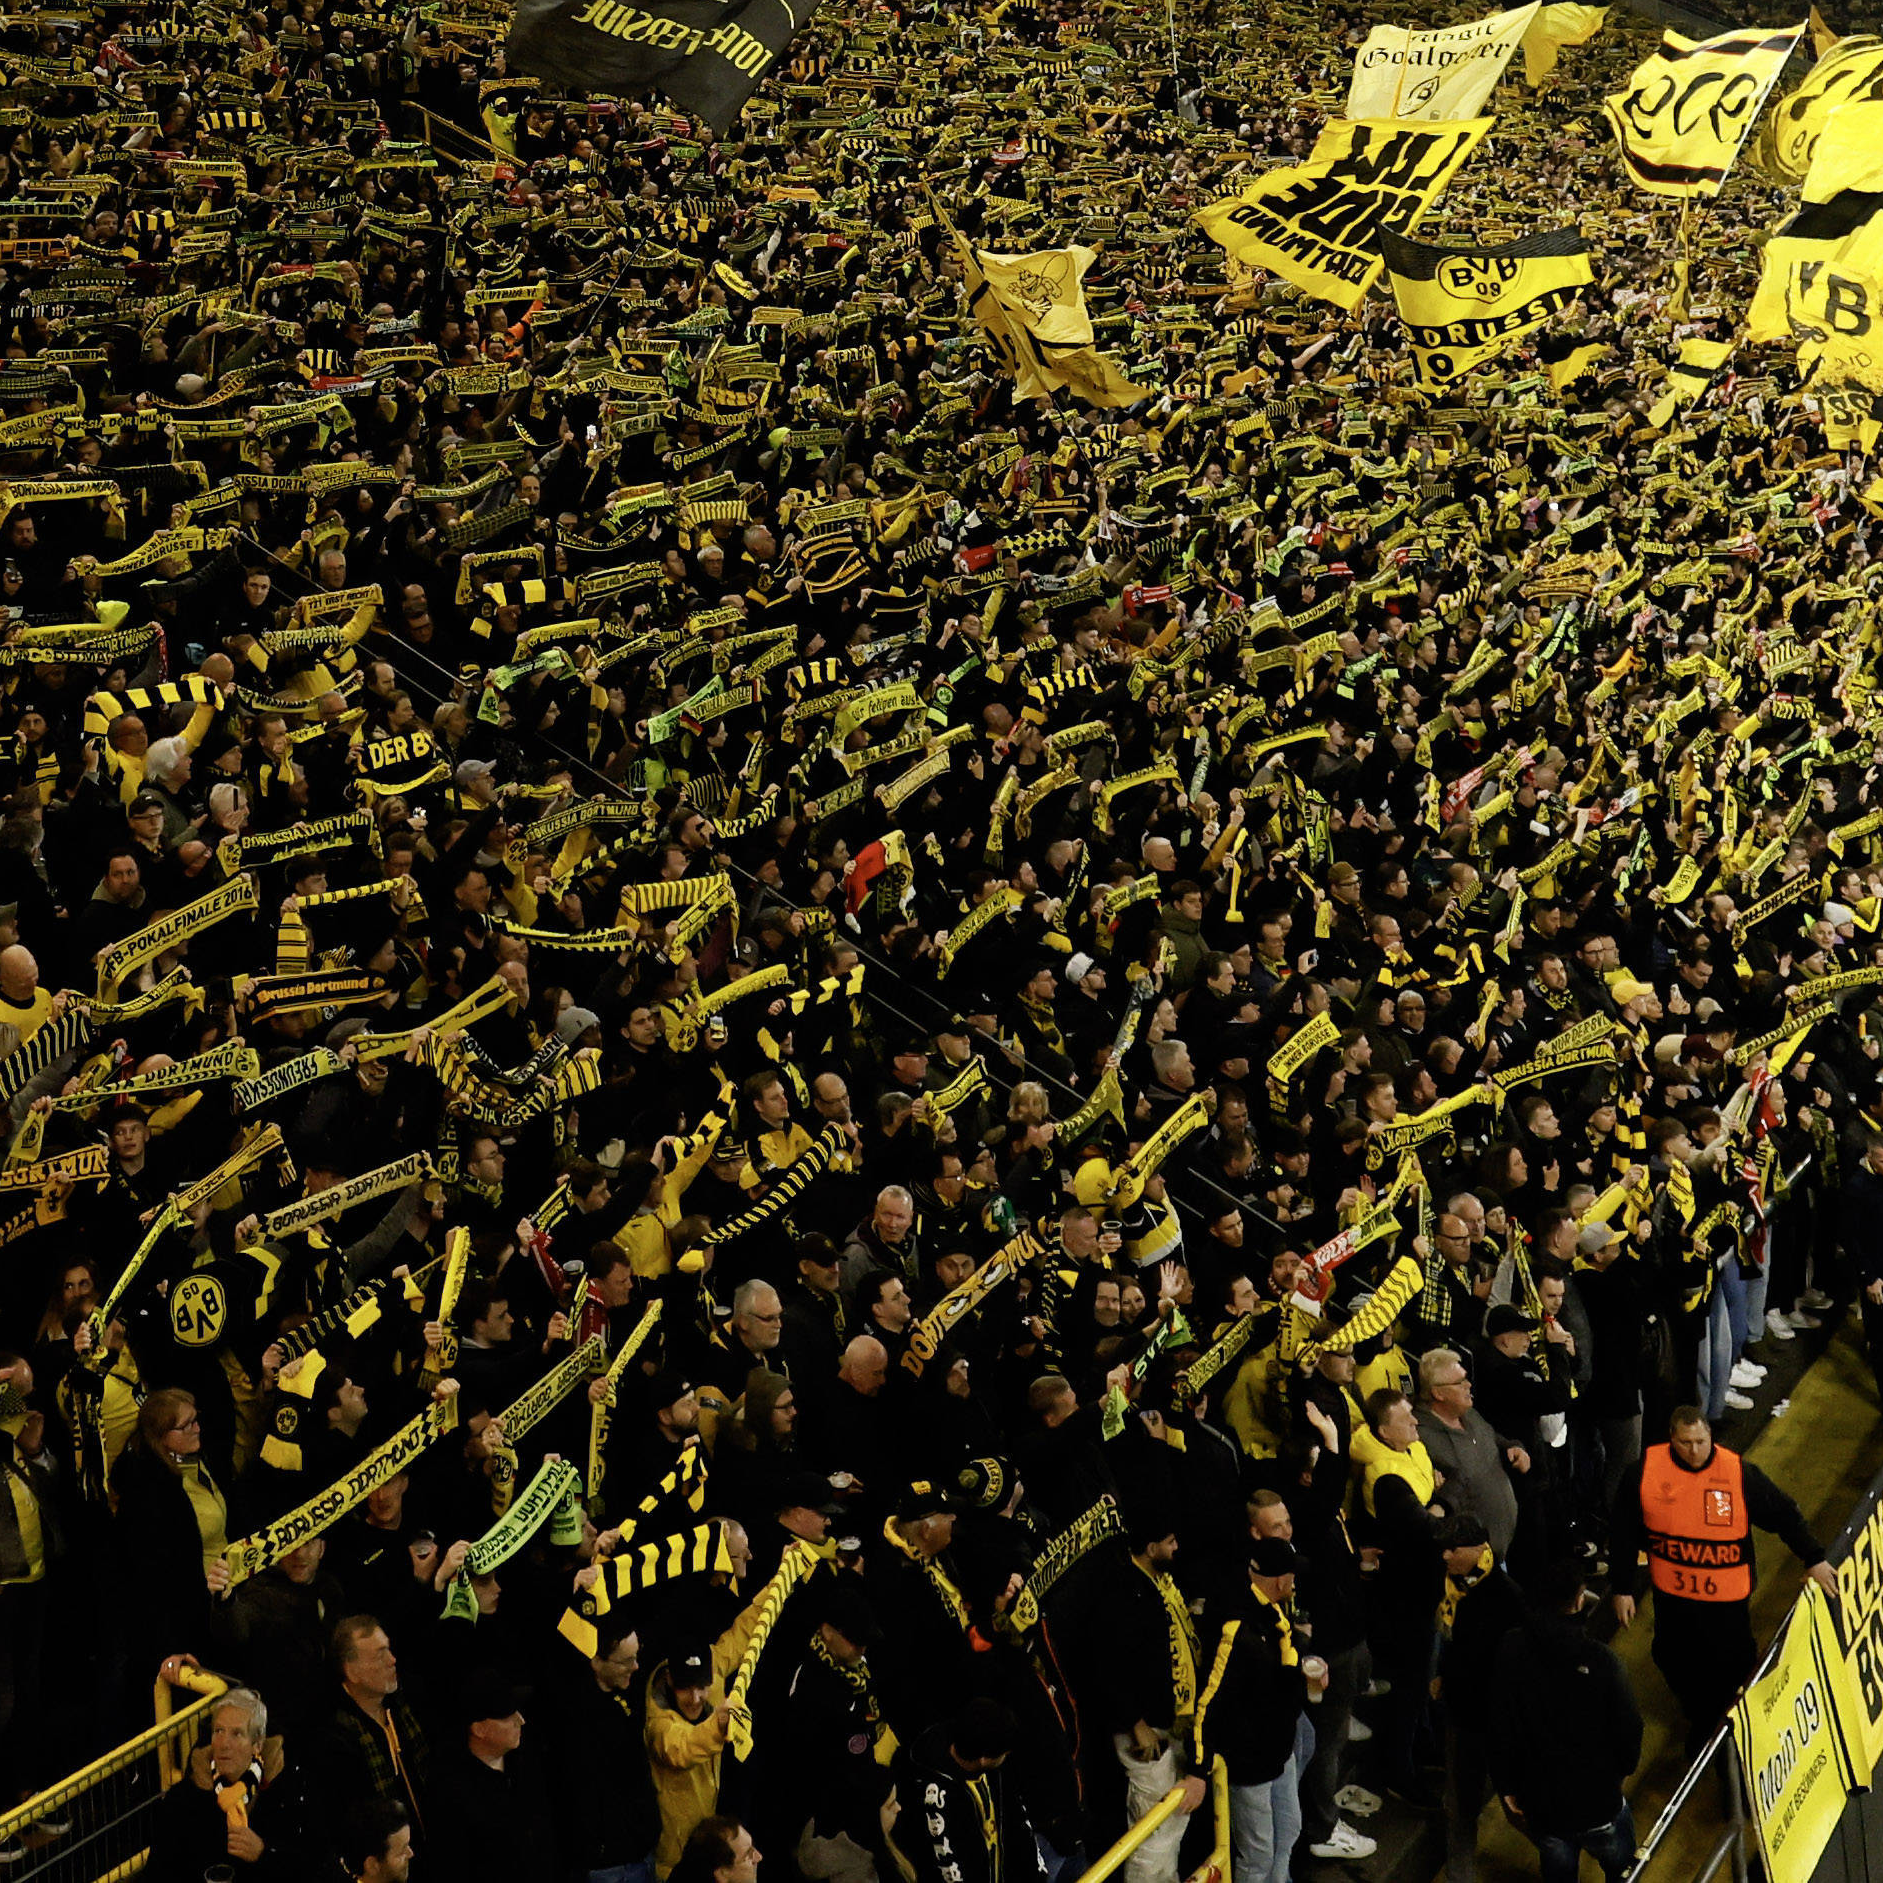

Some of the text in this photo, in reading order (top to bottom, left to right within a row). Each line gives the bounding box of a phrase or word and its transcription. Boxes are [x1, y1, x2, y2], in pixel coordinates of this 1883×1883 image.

[1476, 280, 1501, 298] 09
[367, 737, 409, 769] DER
[304, 812, 371, 837] DORTMUN
[223, 886, 253, 915] 2016
[1555, 1040, 1616, 1068] DORTMUN
[272, 1156, 417, 1231] BORUSSIA DORTMUND
[275, 1426, 423, 1549] BORUSSIA DORTMUND
[1672, 1571, 1718, 1598] 316
[1757, 1726, 1797, 1818] Moin
[1796, 1681, 1821, 1751] 09
